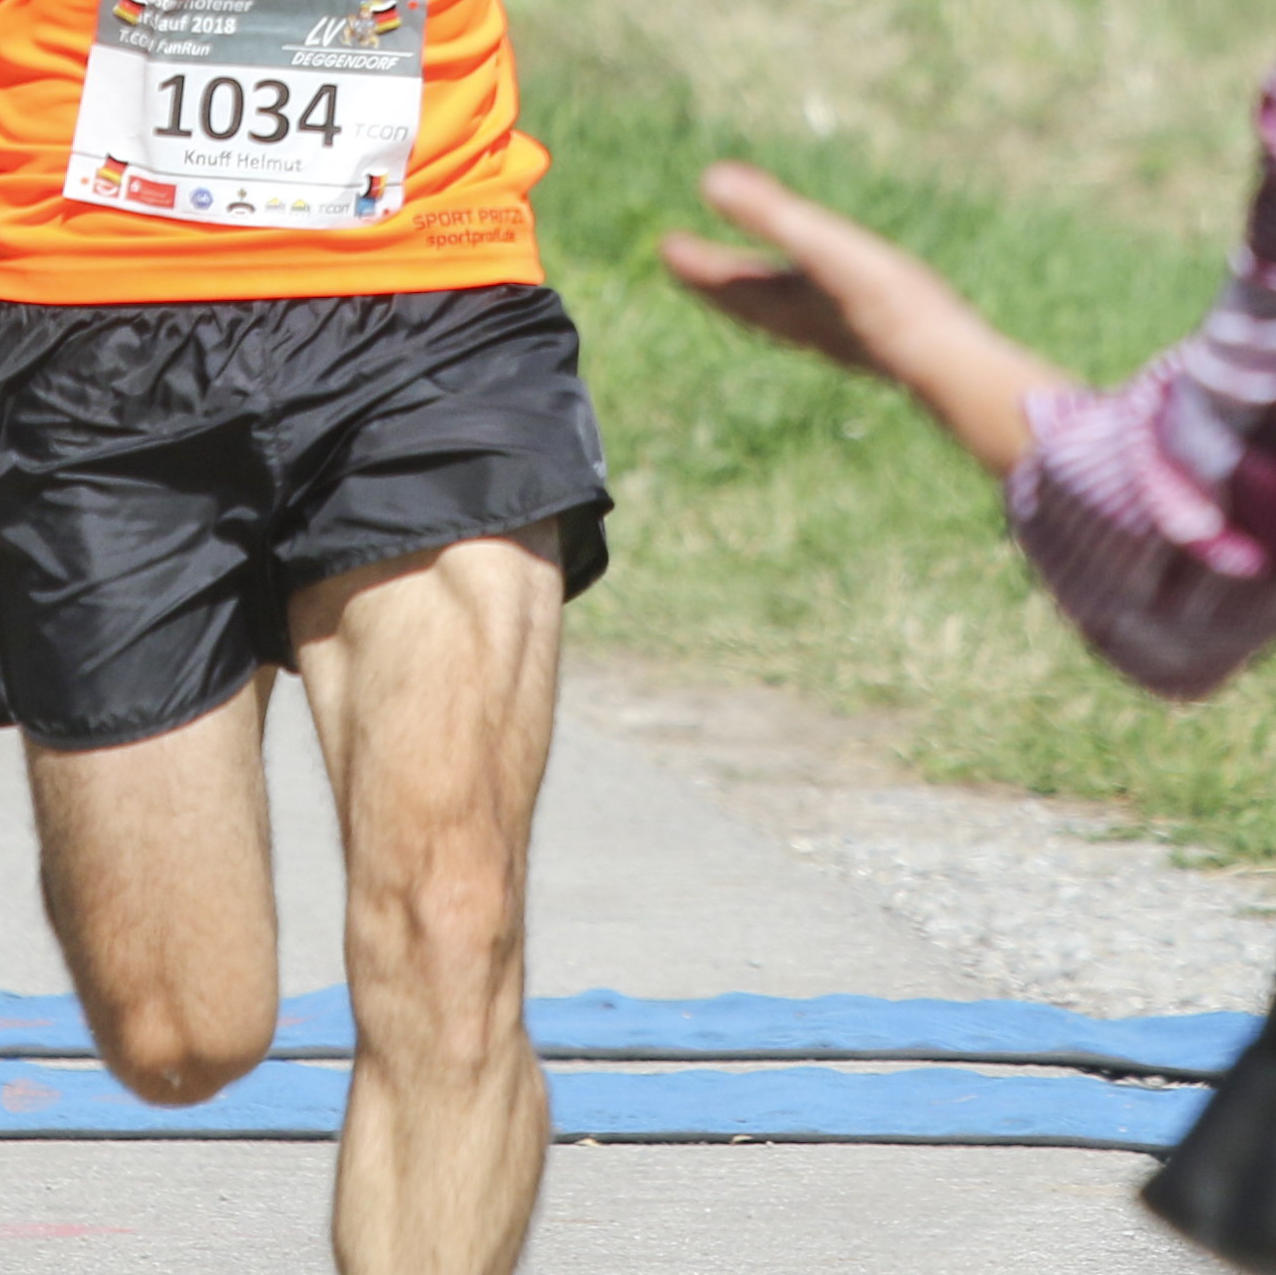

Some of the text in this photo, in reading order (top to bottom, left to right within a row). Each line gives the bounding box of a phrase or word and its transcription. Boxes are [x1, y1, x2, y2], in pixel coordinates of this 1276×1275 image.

[190, 16, 237, 35] 2018
[305, 15, 347, 48] LV
[291, 51, 400, 70] DEGGENDORF
[153, 73, 342, 148] 1034
[183, 149, 302, 173] Knuff Helmut
[413, 210, 473, 231] SPORT
